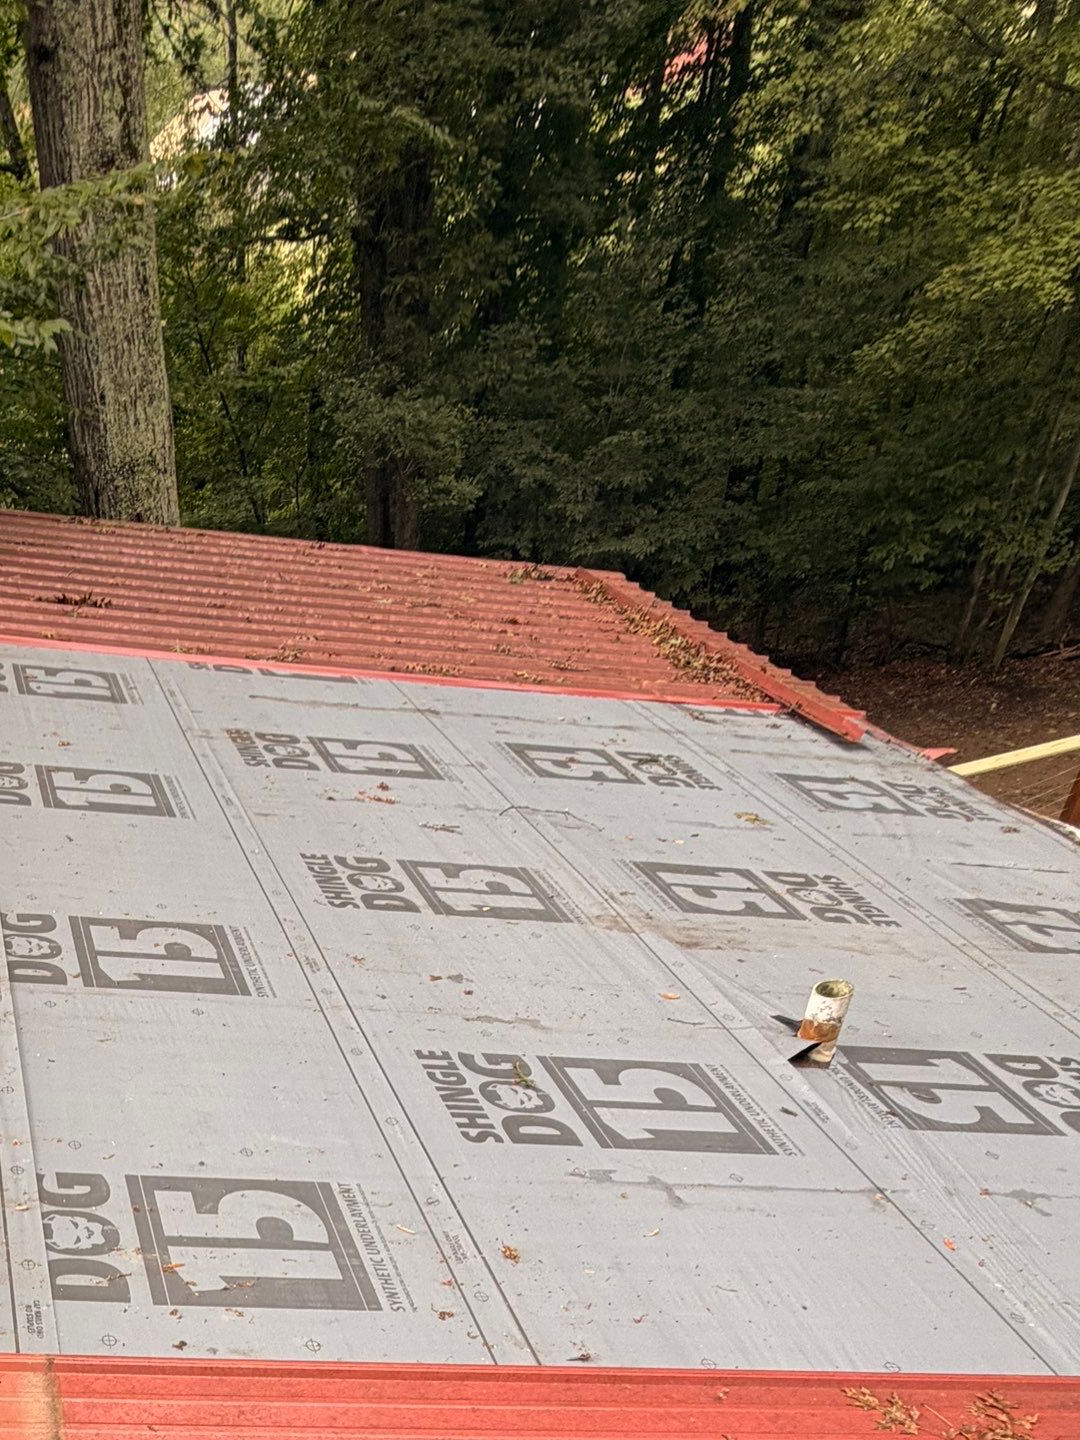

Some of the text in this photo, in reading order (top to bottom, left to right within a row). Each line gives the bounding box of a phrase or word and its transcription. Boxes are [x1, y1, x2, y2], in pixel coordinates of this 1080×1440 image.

[255, 731, 321, 771] DOG
[317, 740, 424, 773] 15
[51, 771, 157, 807] 15
[299, 852, 361, 909] SHINGLE
[334, 855, 422, 913] DOG
[417, 866, 546, 911] 15
[655, 871, 788, 914] 15
[762, 870, 872, 925] DOG
[812, 874, 903, 928] SHINGLE
[1, 913, 68, 985] DOG
[89, 924, 225, 982] 15
[414, 1049, 504, 1144] SHINGLE
[458, 1051, 583, 1147] DOG
[563, 1066, 740, 1141] 15
[856, 1058, 1035, 1125] 15
[983, 1053, 1080, 1134] DO
[36, 1172, 132, 1303] DOG
[153, 1189, 344, 1295] 15
[337, 1181, 381, 1256] UNDERLAYMENT
[369, 1257, 406, 1312] SYNTHETIC
